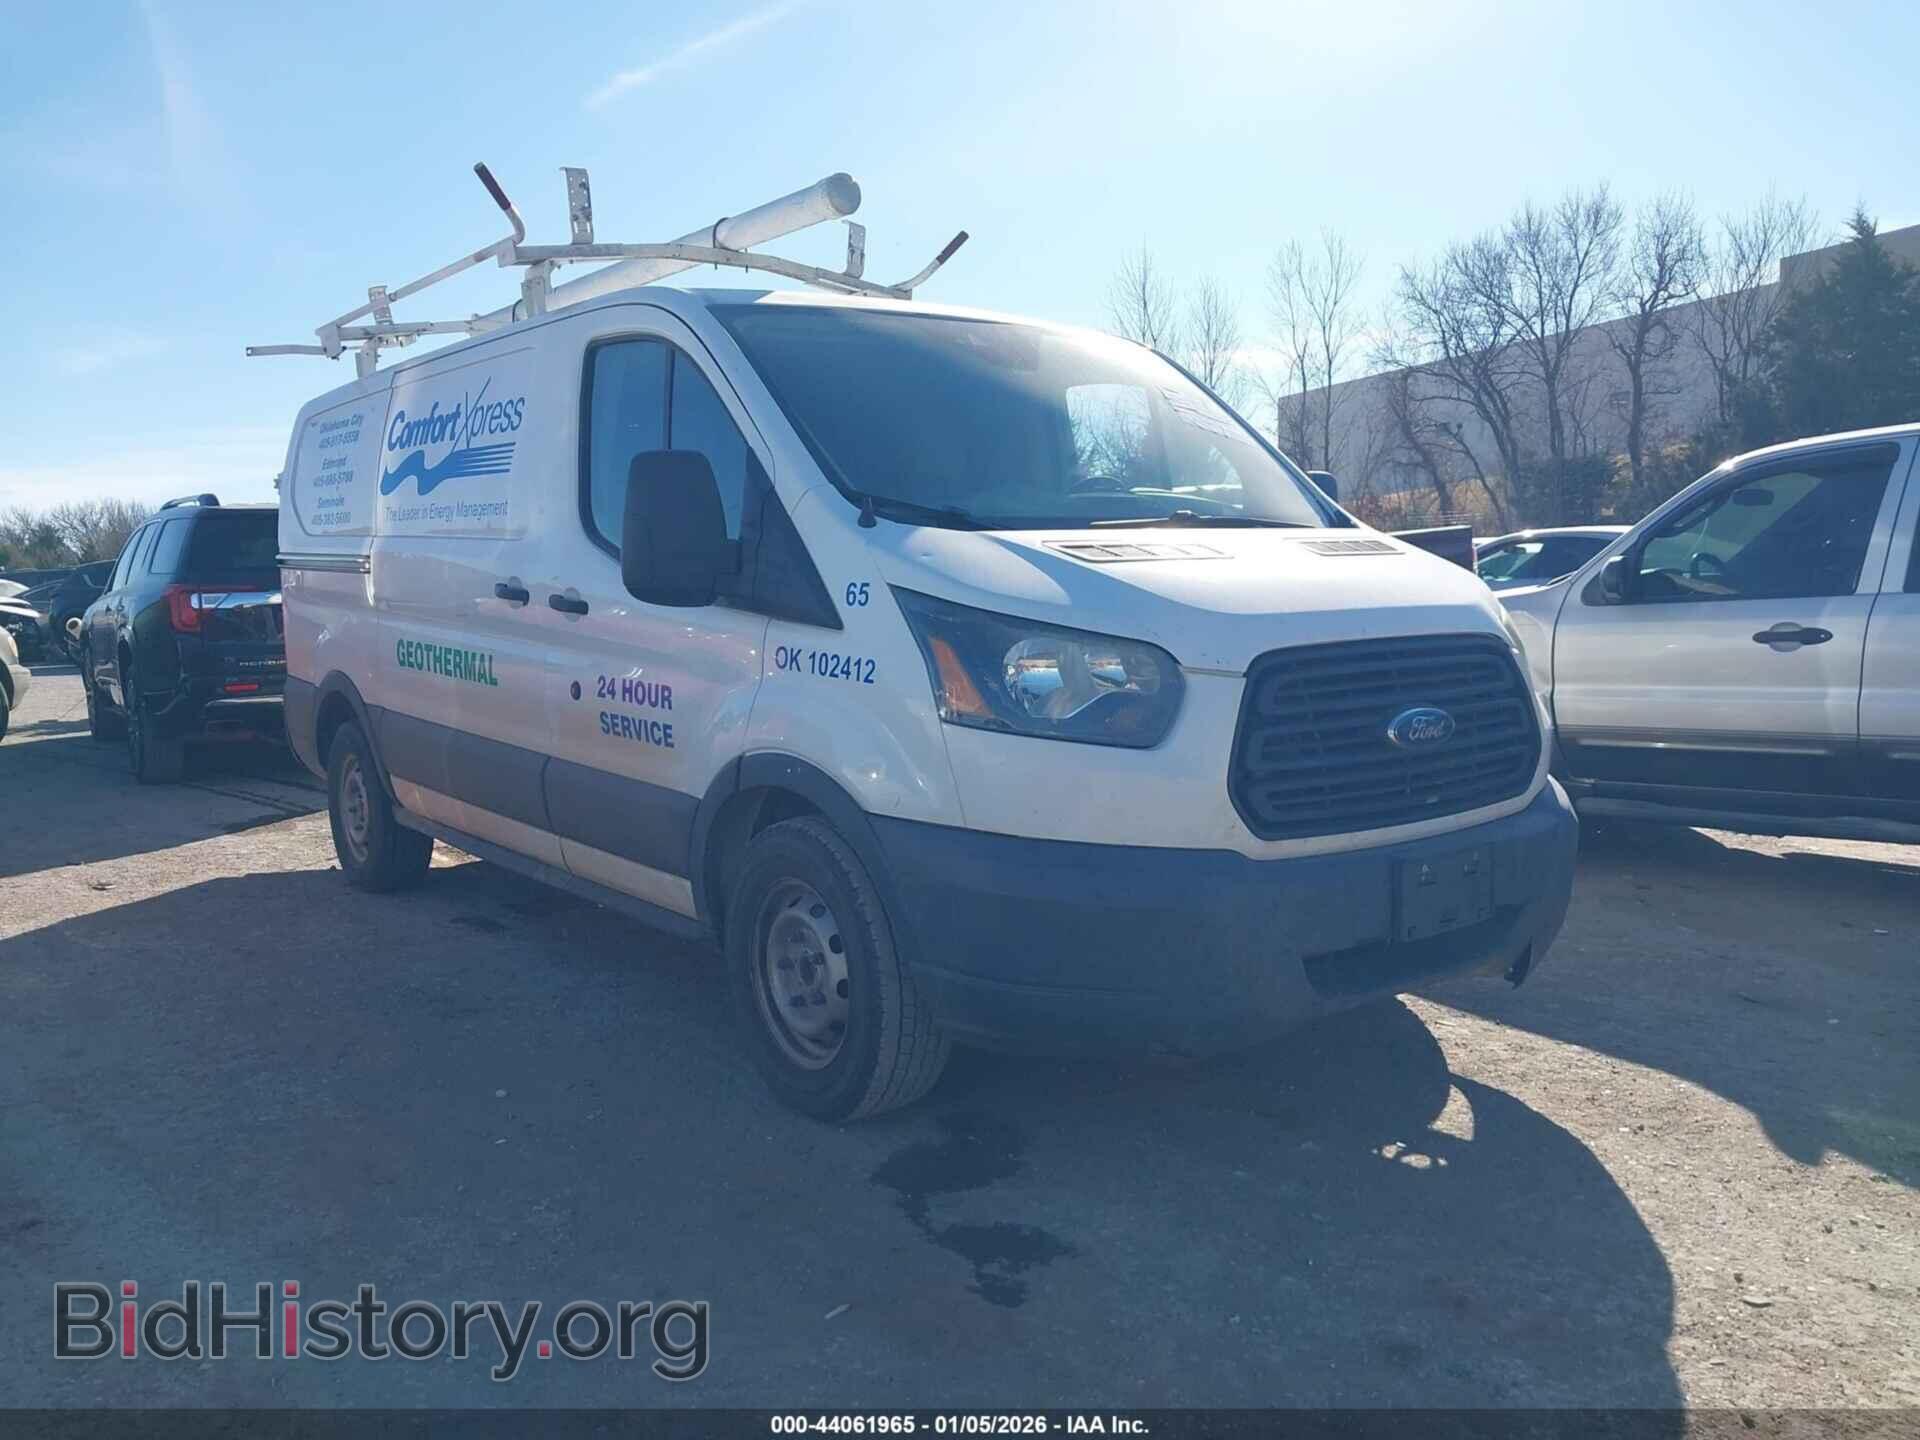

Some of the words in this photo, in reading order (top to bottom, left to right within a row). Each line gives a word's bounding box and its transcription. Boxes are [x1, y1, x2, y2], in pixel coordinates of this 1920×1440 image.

[385, 507, 397, 520] The
[398, 505, 421, 521] Leader
[429, 503, 455, 523] Energy
[456, 499, 508, 521] Management
[846, 582, 870, 607] 65
[396, 638, 498, 687] GEOTHERMAL
[775, 646, 802, 673] OK
[808, 650, 876, 684] 102412
[597, 675, 616, 700] 24
[621, 678, 673, 711] HOUR
[600, 710, 675, 748] SERVICE
[1408, 716, 1446, 741] Ford
